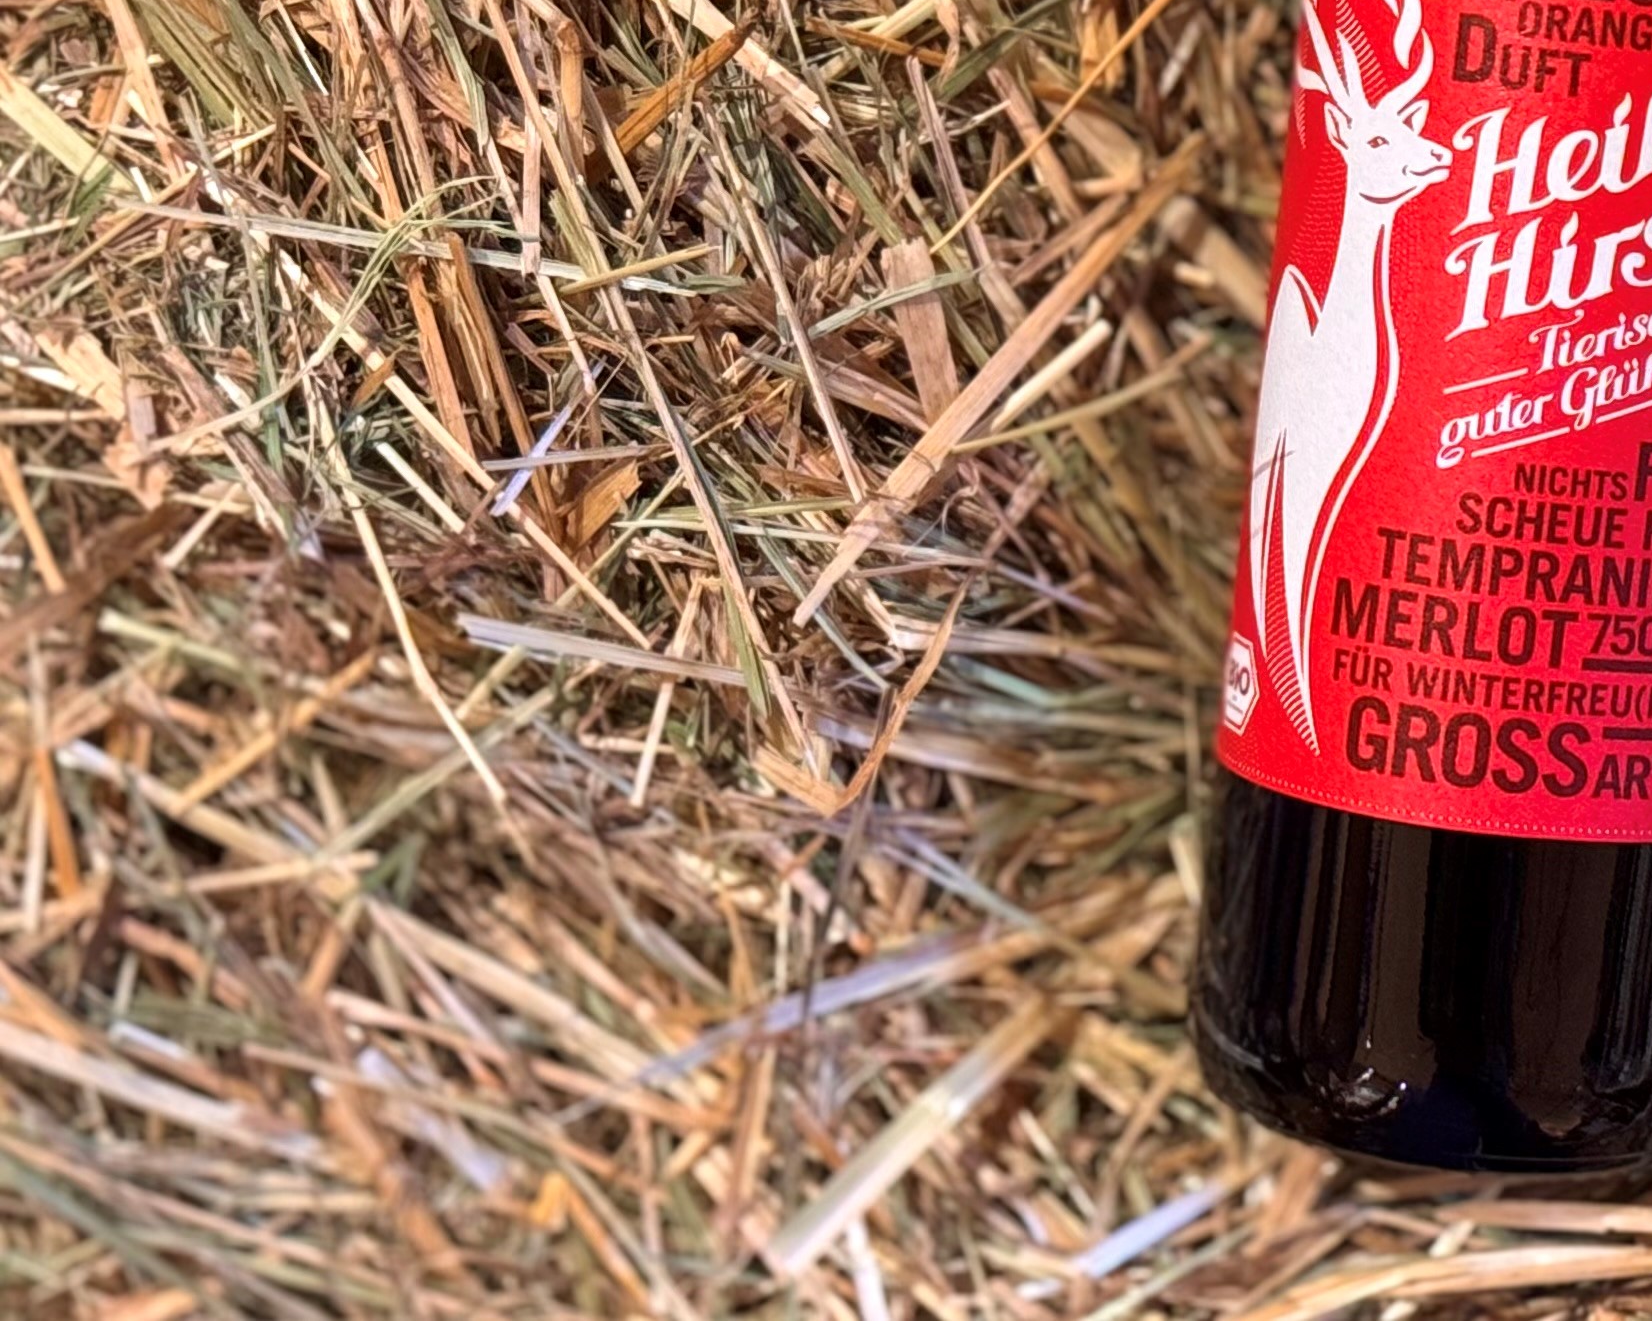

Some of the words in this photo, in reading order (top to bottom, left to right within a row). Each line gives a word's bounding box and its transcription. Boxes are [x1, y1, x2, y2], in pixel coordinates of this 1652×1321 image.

[1452, 12, 1592, 98] DUFT
[1435, 391, 1554, 470] guter
[1455, 492, 1630, 550] SCHEUE
[1513, 463, 1629, 502] NICHTS
[1330, 577, 1581, 669] MERLOT
[1331, 648, 1395, 692] FÜR
[1345, 696, 1591, 798] GROSS
